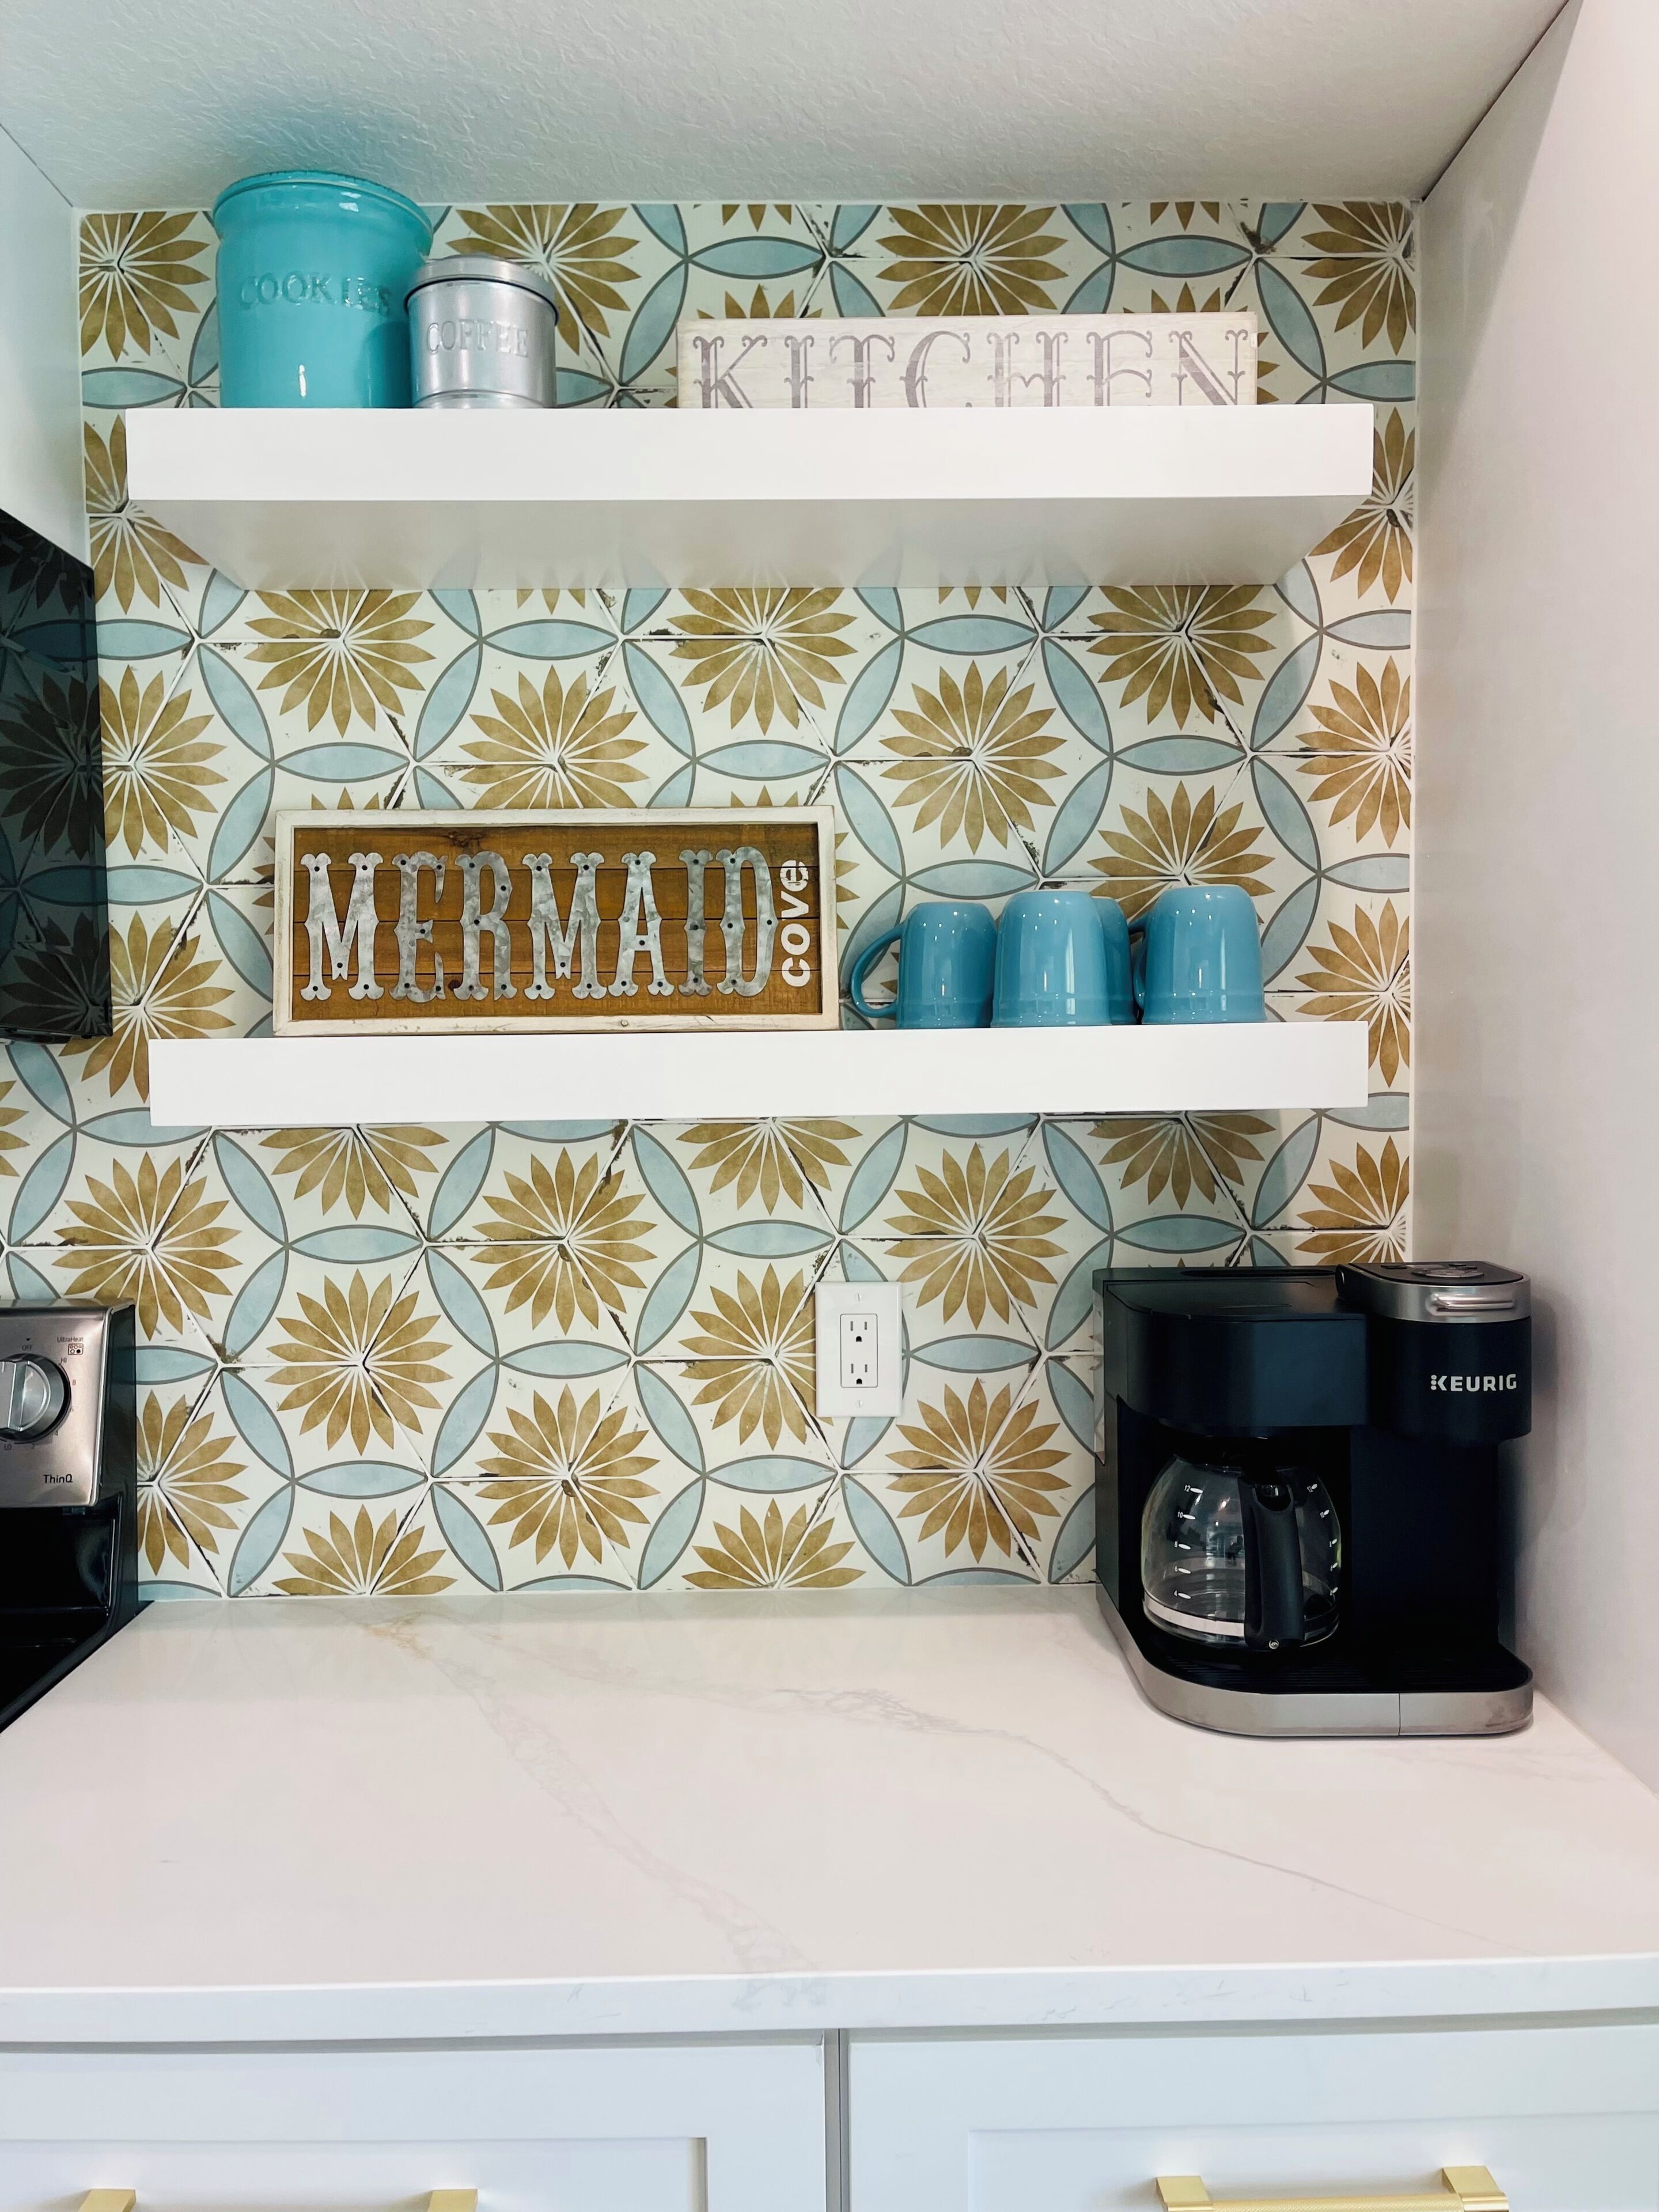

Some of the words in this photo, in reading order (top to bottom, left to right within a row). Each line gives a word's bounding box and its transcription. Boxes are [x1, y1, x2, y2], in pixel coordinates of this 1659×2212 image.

[240, 271, 391, 316] COOKIES
[426, 319, 528, 357] COFFEE
[693, 331, 1248, 407] KITCHEN
[300, 847, 779, 1003] MERMAID
[778, 859, 812, 987] cove
[1430, 1374, 1517, 1392] KEURIG
[43, 1474, 73, 1484] ThinQ
